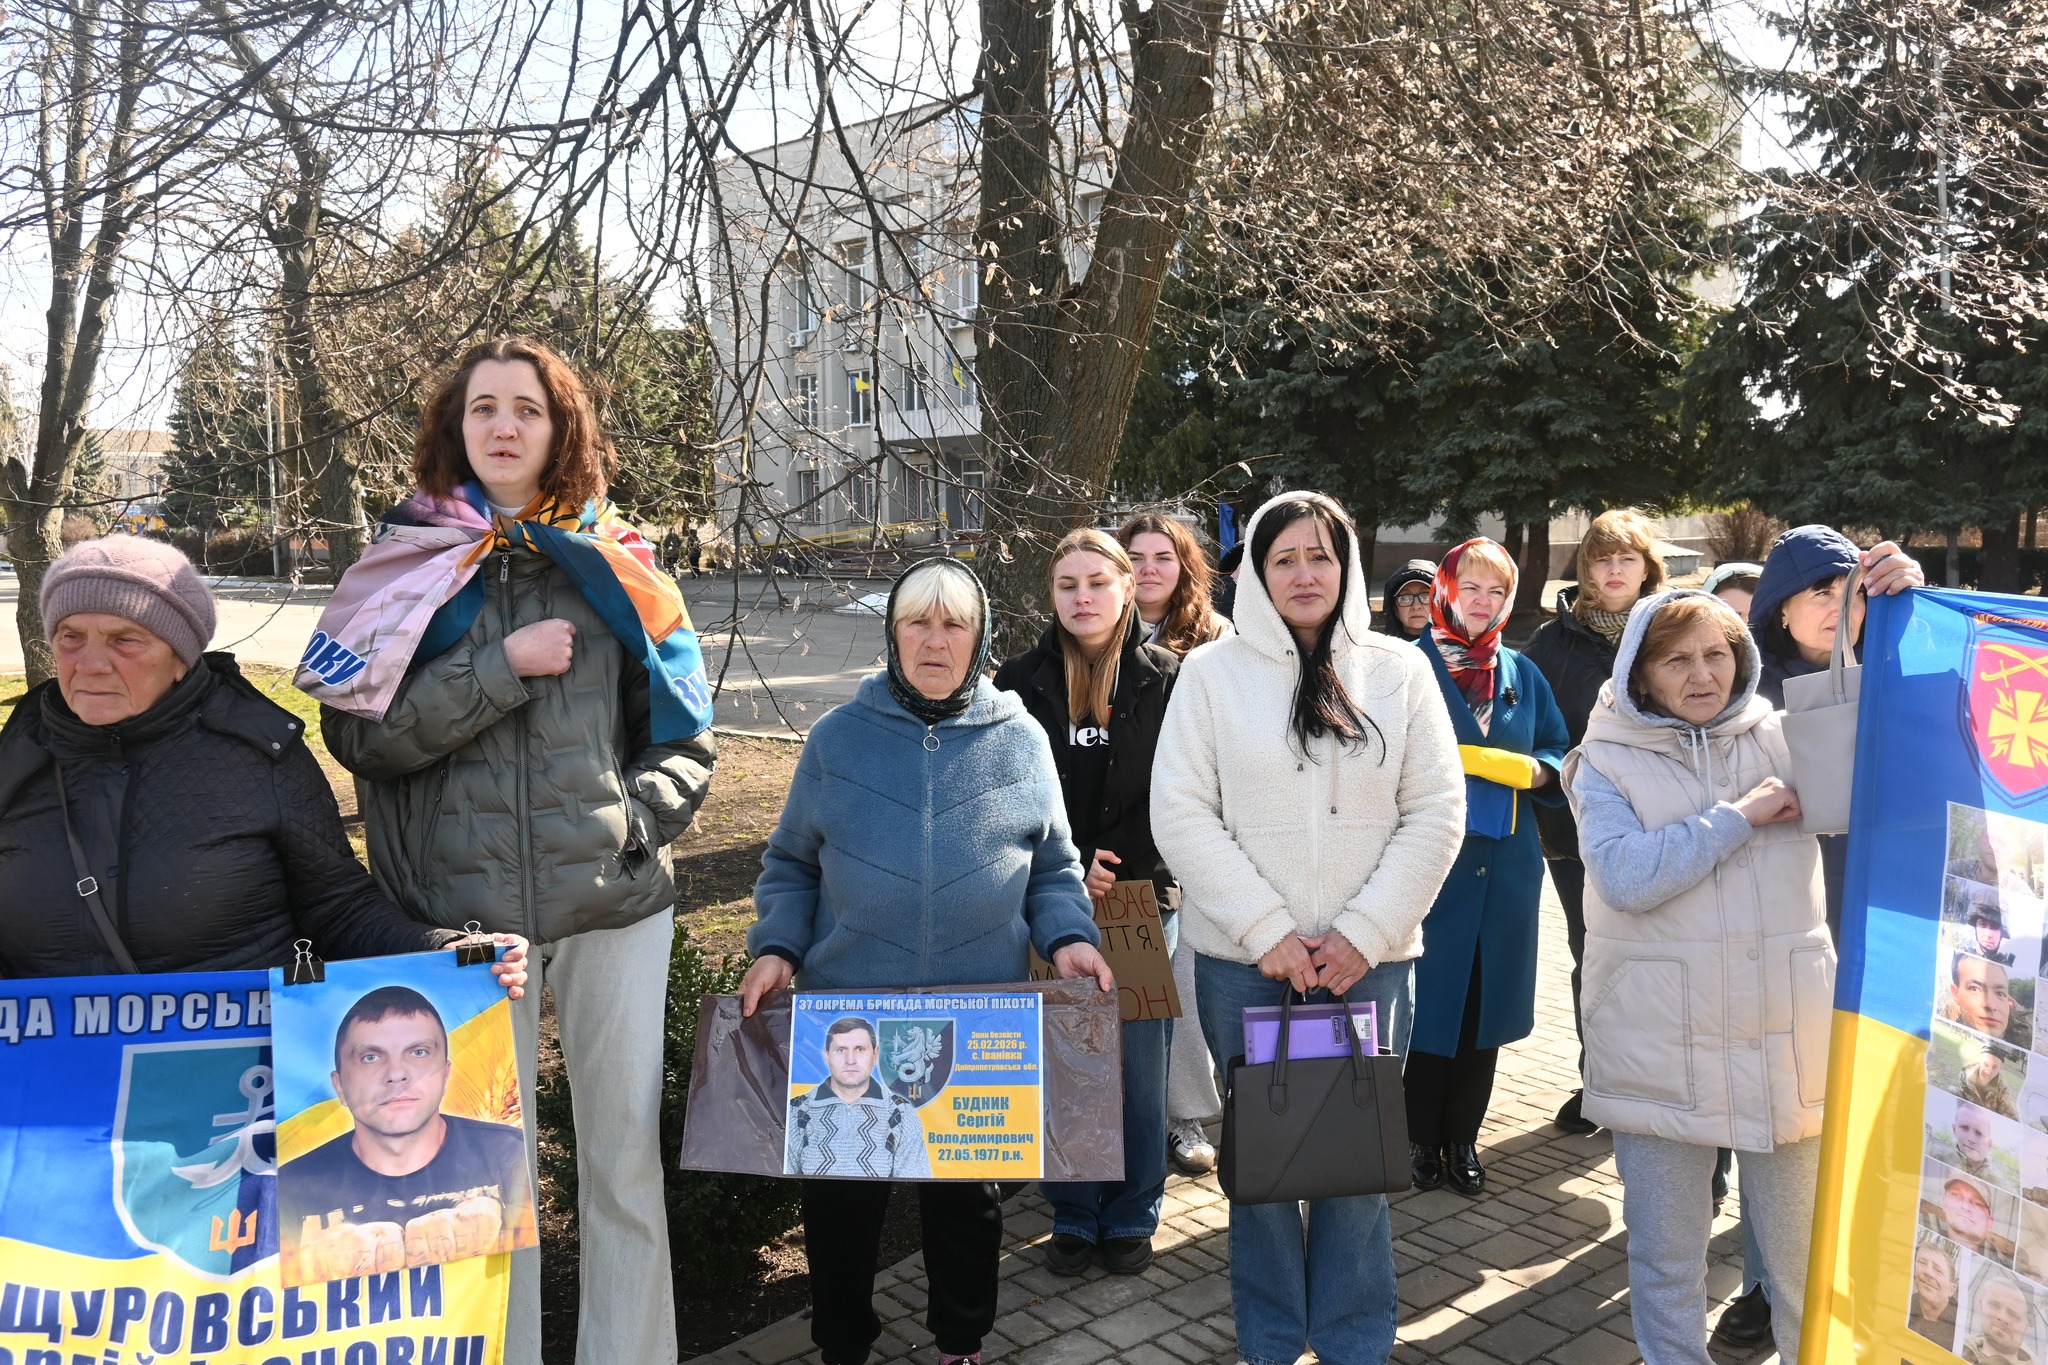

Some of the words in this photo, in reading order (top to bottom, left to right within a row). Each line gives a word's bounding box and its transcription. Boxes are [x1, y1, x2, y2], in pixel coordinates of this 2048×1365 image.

[798, 998, 813, 1011] 37
[815, 998, 864, 1011] ОКРЕМА
[867, 998, 922, 1011] БРИГАДА
[924, 996, 989, 1010] МОРСЬКОЇ
[991, 997, 1035, 1010] ПІХОТИ
[971, 1031, 989, 1039] Зник
[990, 1031, 1022, 1039] безвісти
[967, 1039, 1018, 1050] 25.02.2026
[1019, 1041, 1027, 1050] р.
[982, 1051, 1022, 1060] Іванівка
[955, 1063, 1022, 1072] Дніпропетровська
[1023, 1063, 1038, 1071] обл.
[953, 1096, 1010, 1112] БУДНИК
[957, 1112, 1005, 1128] Сергій
[928, 1131, 1034, 1145] Володимирович
[938, 1148, 999, 1161] 27.05.1977
[1002, 1150, 1024, 1162] р.н.
